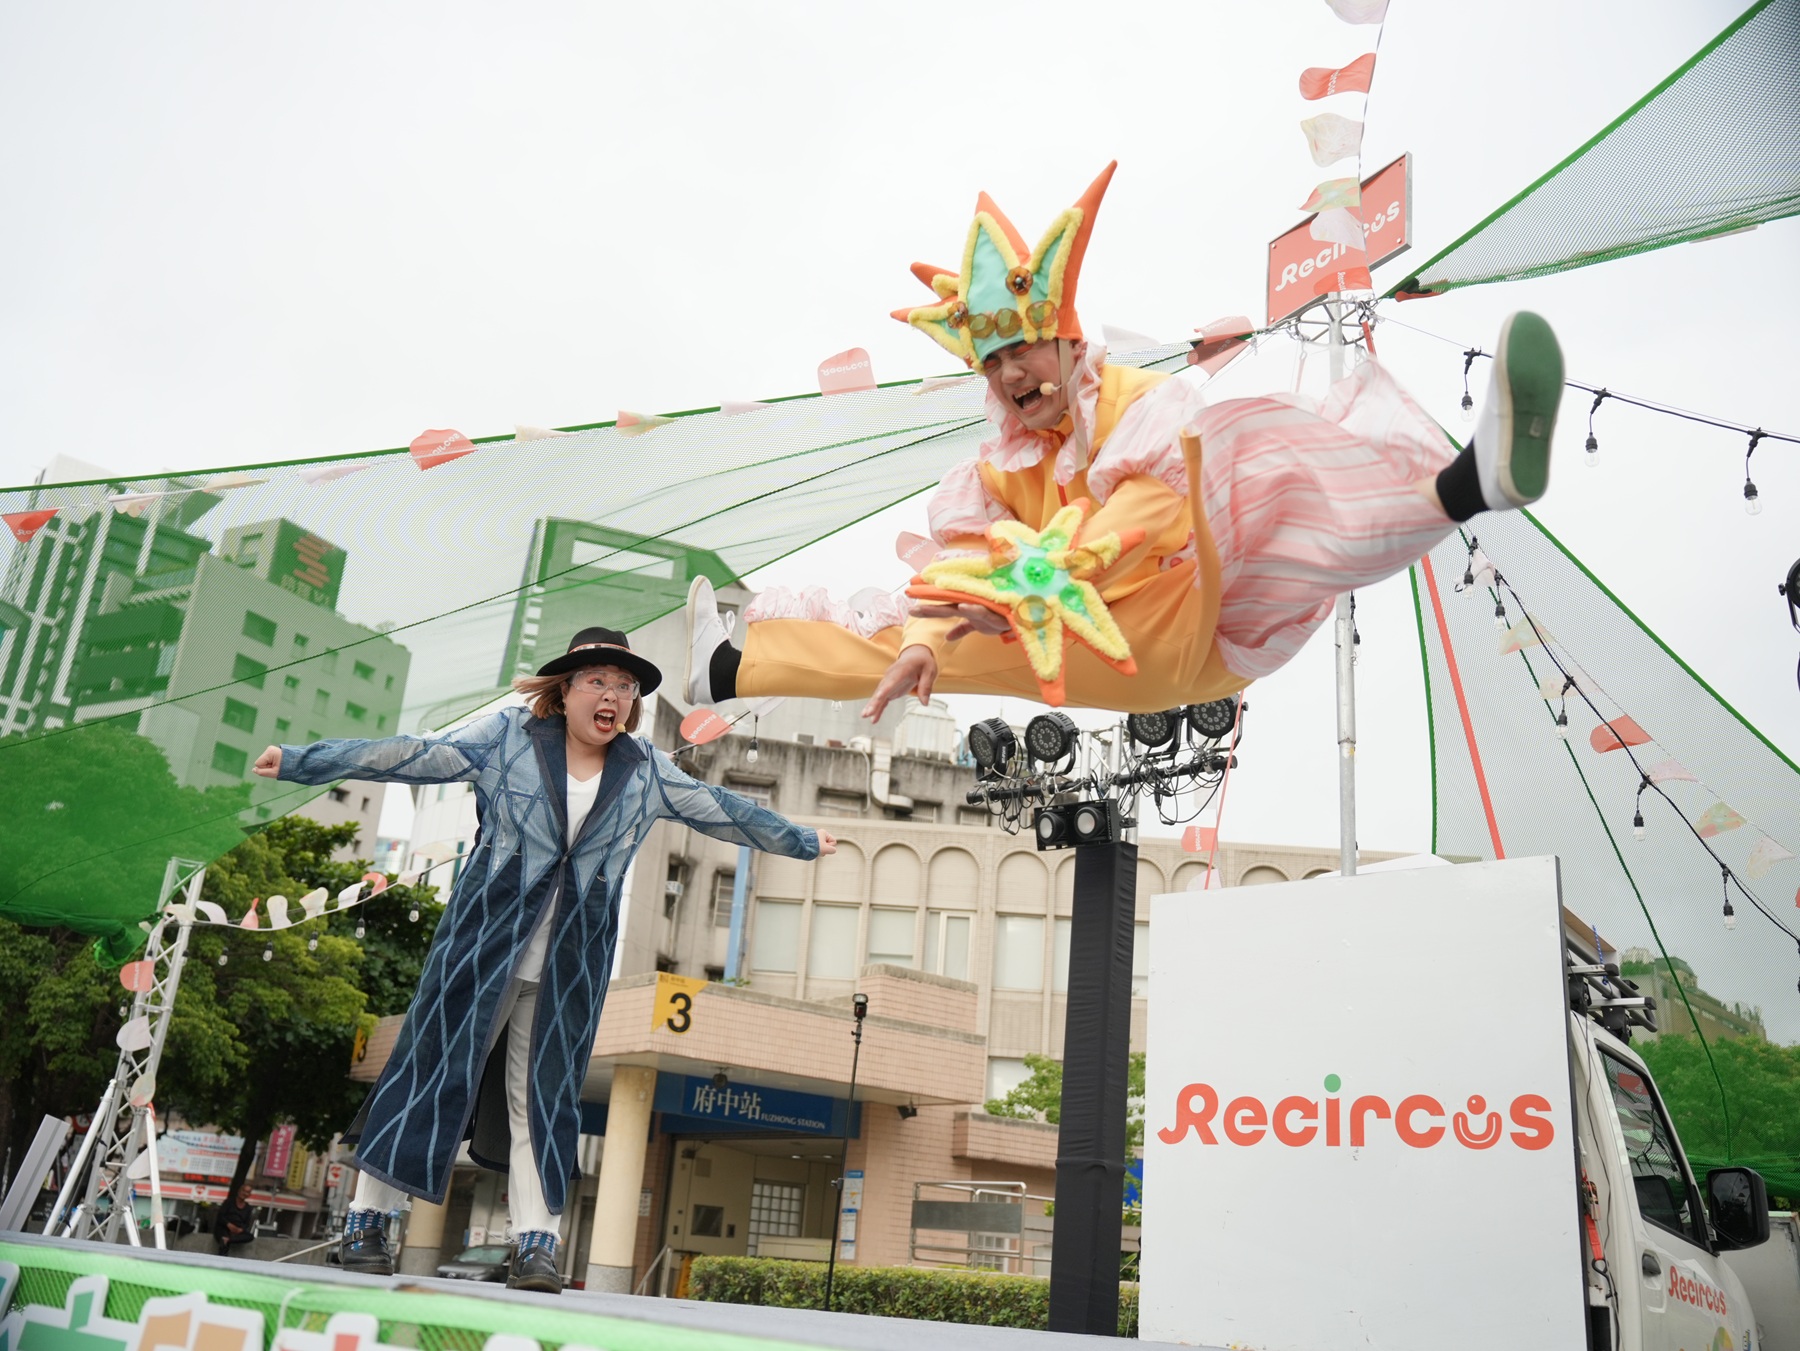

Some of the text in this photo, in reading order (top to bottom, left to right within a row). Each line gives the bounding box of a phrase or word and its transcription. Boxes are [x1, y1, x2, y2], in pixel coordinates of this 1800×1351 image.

[667, 992, 692, 1034] 3
[692, 1084, 762, 1121] 府中站
[761, 1112, 826, 1129] FUZHONG STATION
[1157, 1073, 1555, 1151] Recircus
[1668, 1265, 1727, 1316] Recircus
